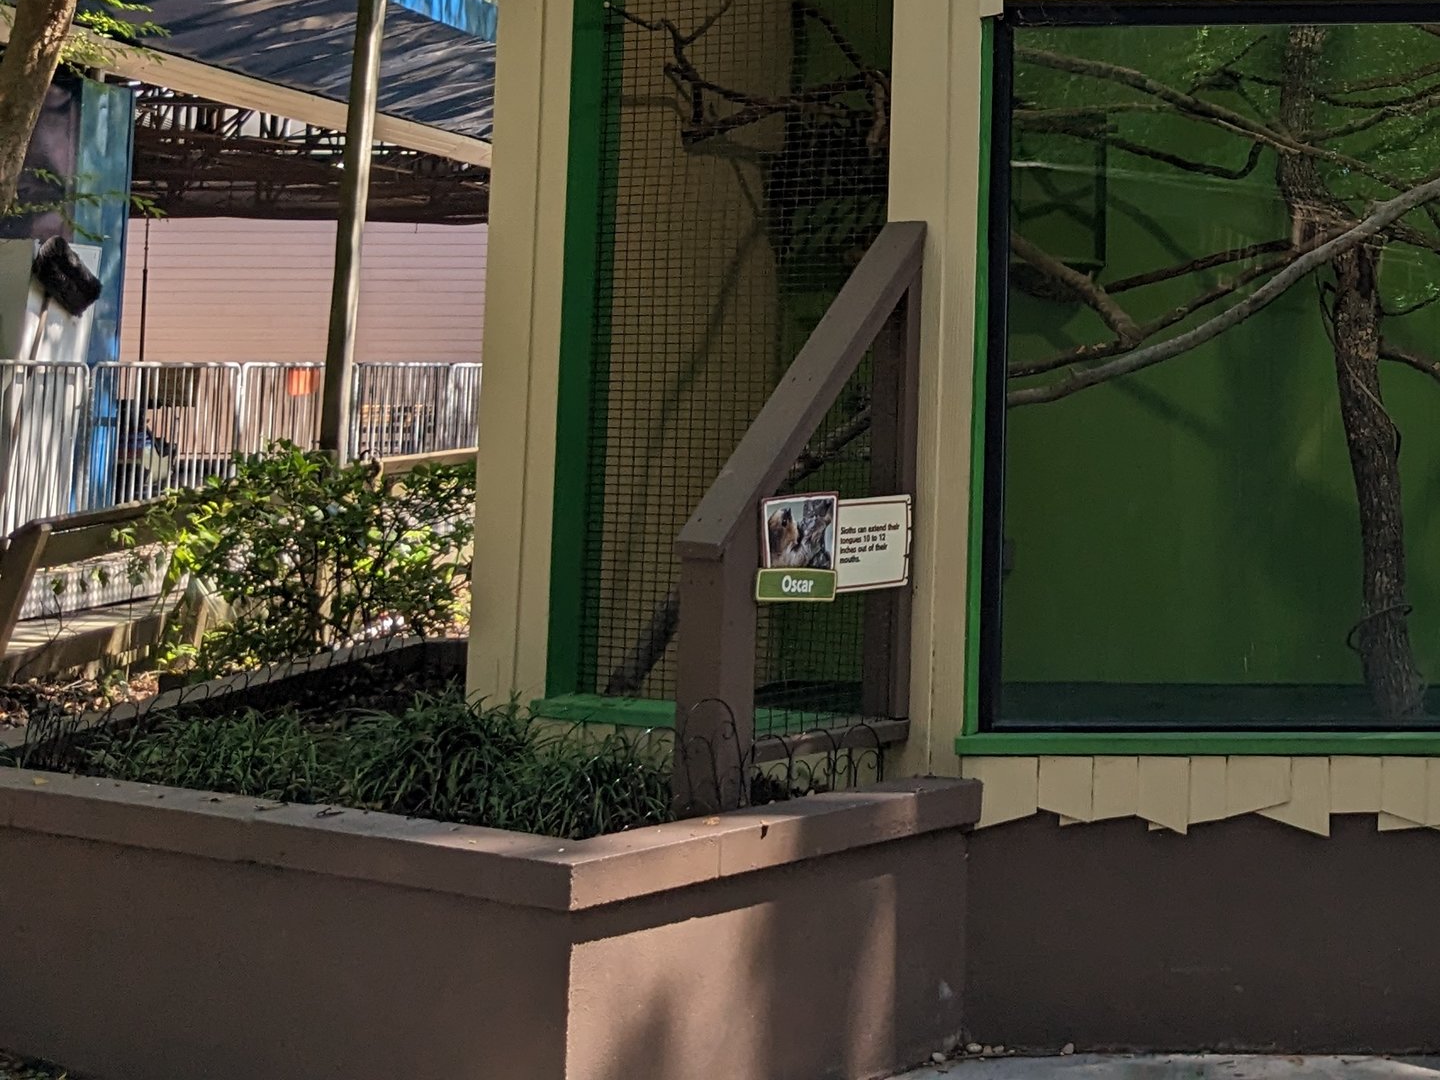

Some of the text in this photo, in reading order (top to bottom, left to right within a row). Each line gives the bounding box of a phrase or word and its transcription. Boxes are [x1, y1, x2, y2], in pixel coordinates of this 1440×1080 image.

[868, 524, 886, 532] extend
[879, 533, 885, 541] 12
[840, 546, 856, 554] inches
[875, 543, 887, 551] their
[782, 575, 814, 593] Oscar
